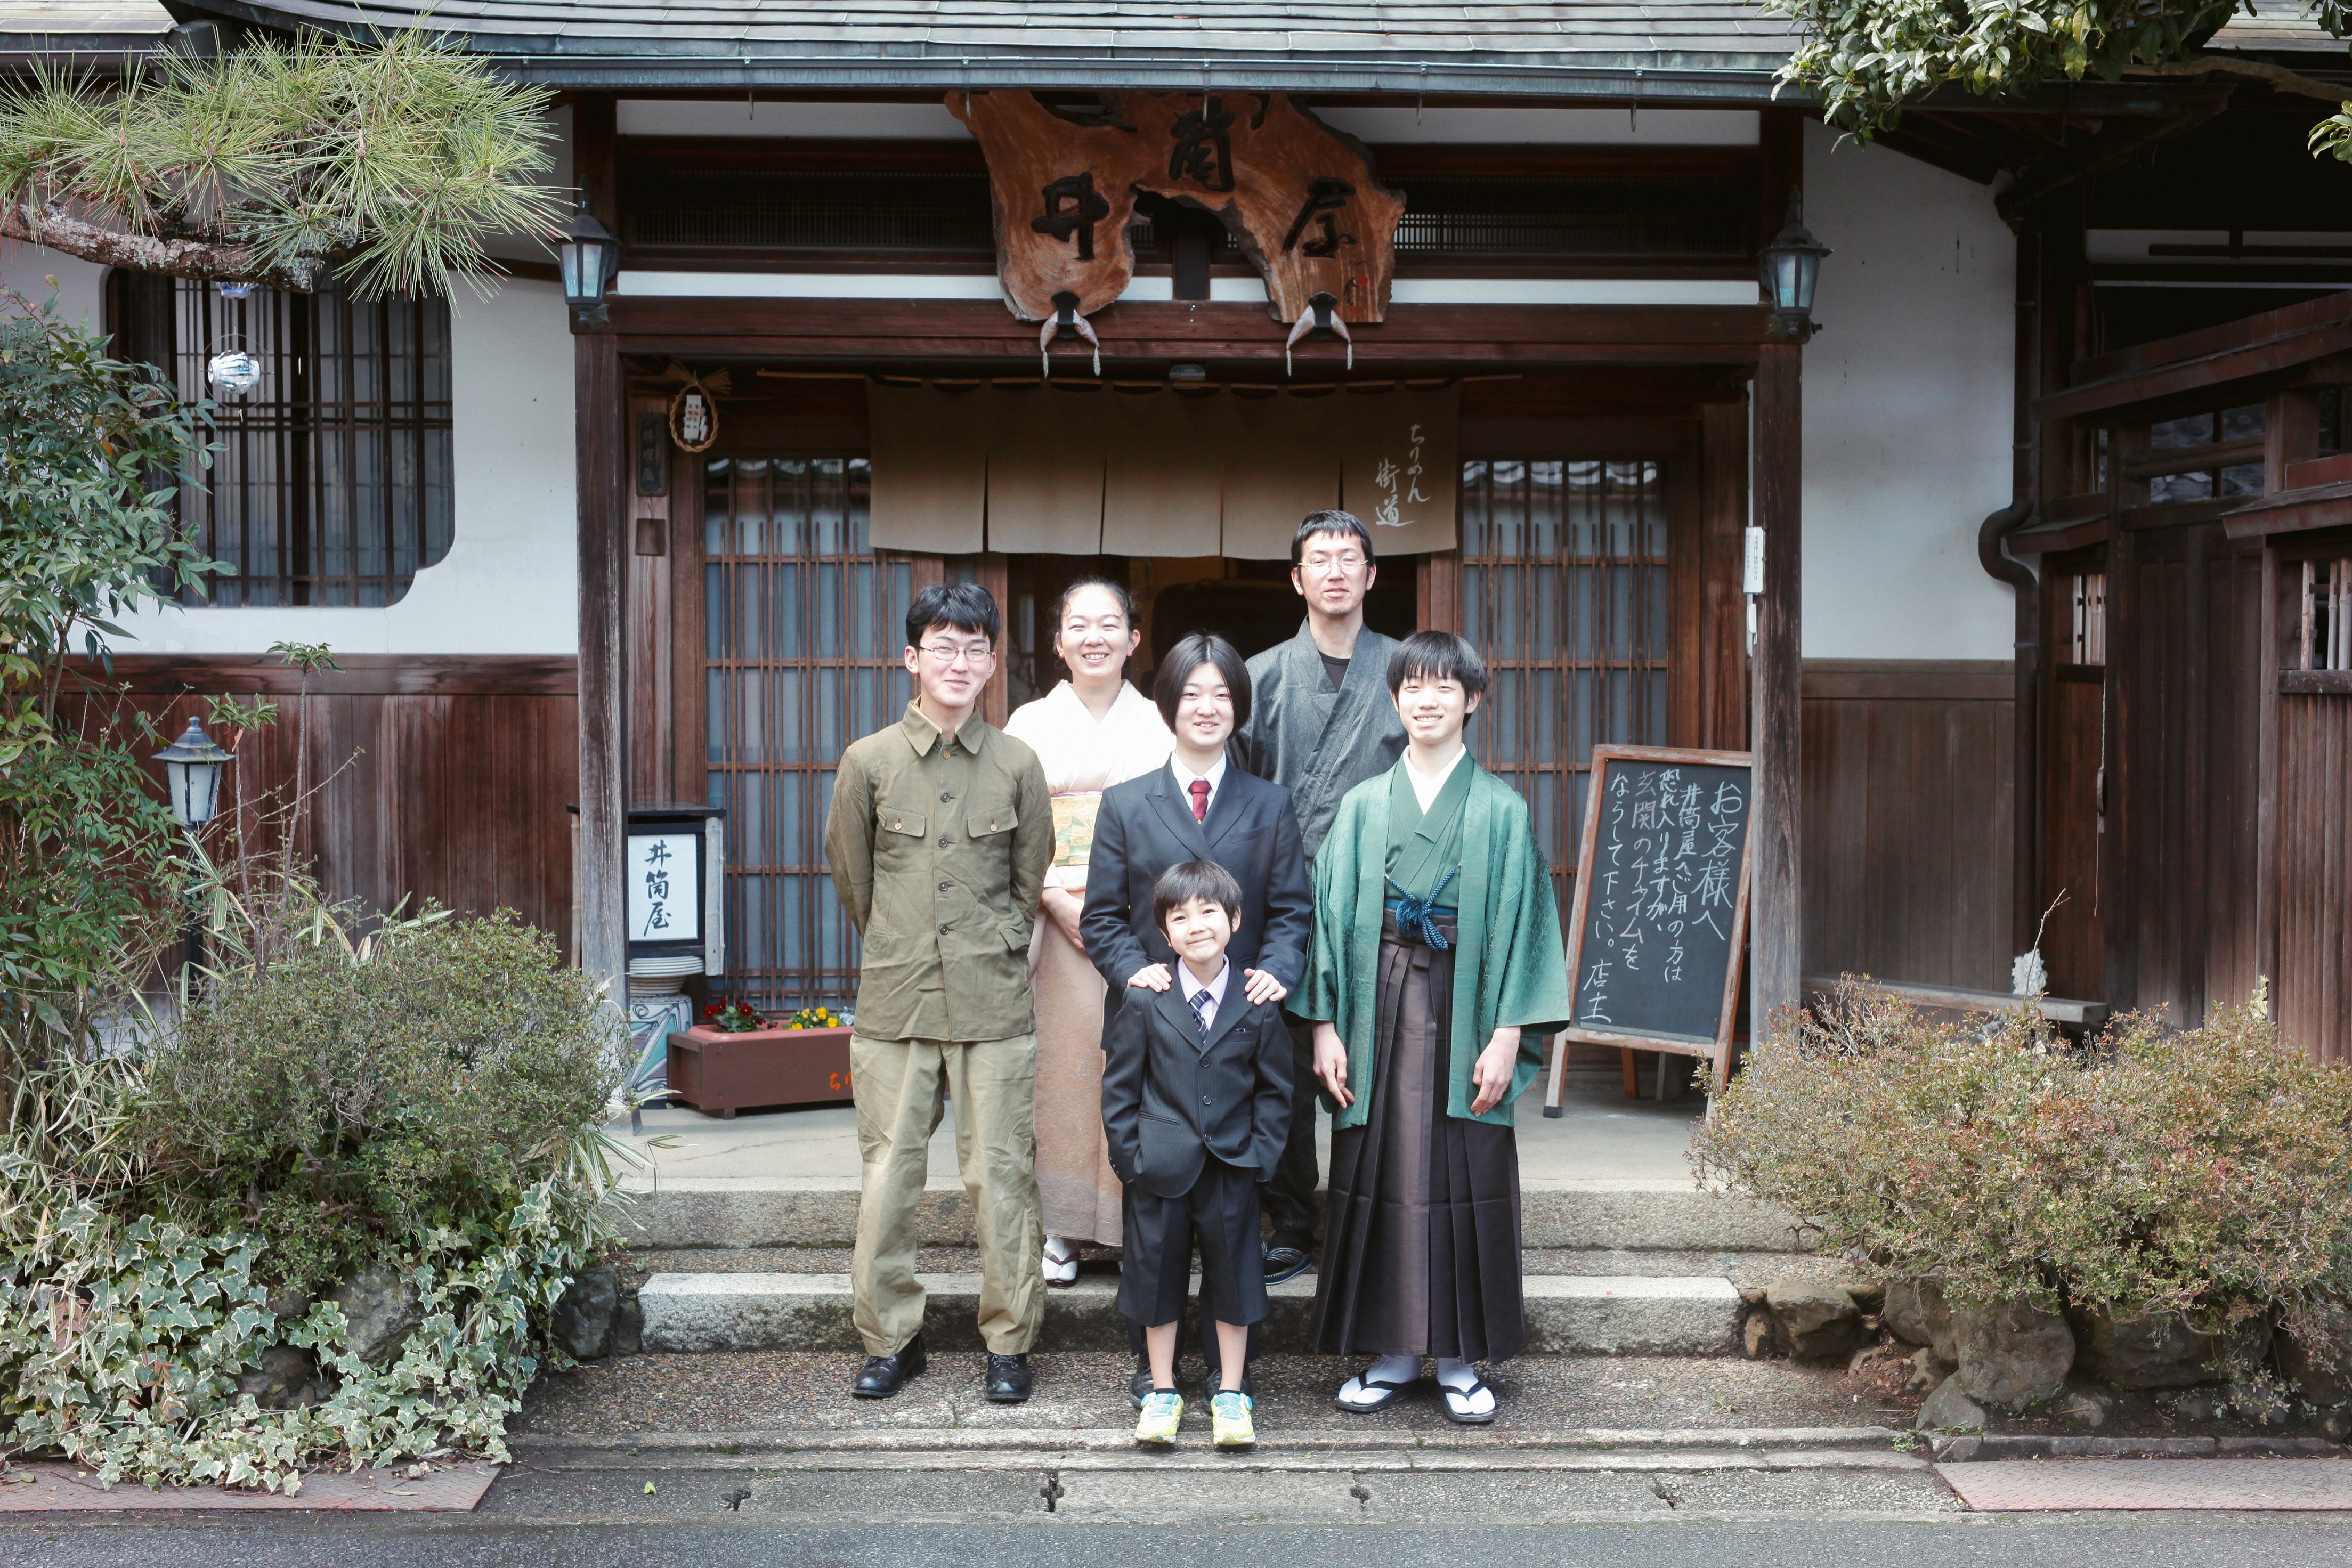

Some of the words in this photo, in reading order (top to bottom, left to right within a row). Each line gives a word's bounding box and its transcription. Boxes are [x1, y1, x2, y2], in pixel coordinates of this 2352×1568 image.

[1375, 458, 1416, 527] 街道
[1407, 424, 1430, 503] ちりめん
[644, 839, 672, 937] 井筒屋
[1664, 782, 1704, 982] 井筒屋へご用の方は
[1691, 781, 1742, 940] お客様へ
[1580, 958, 1612, 1023] 店主
